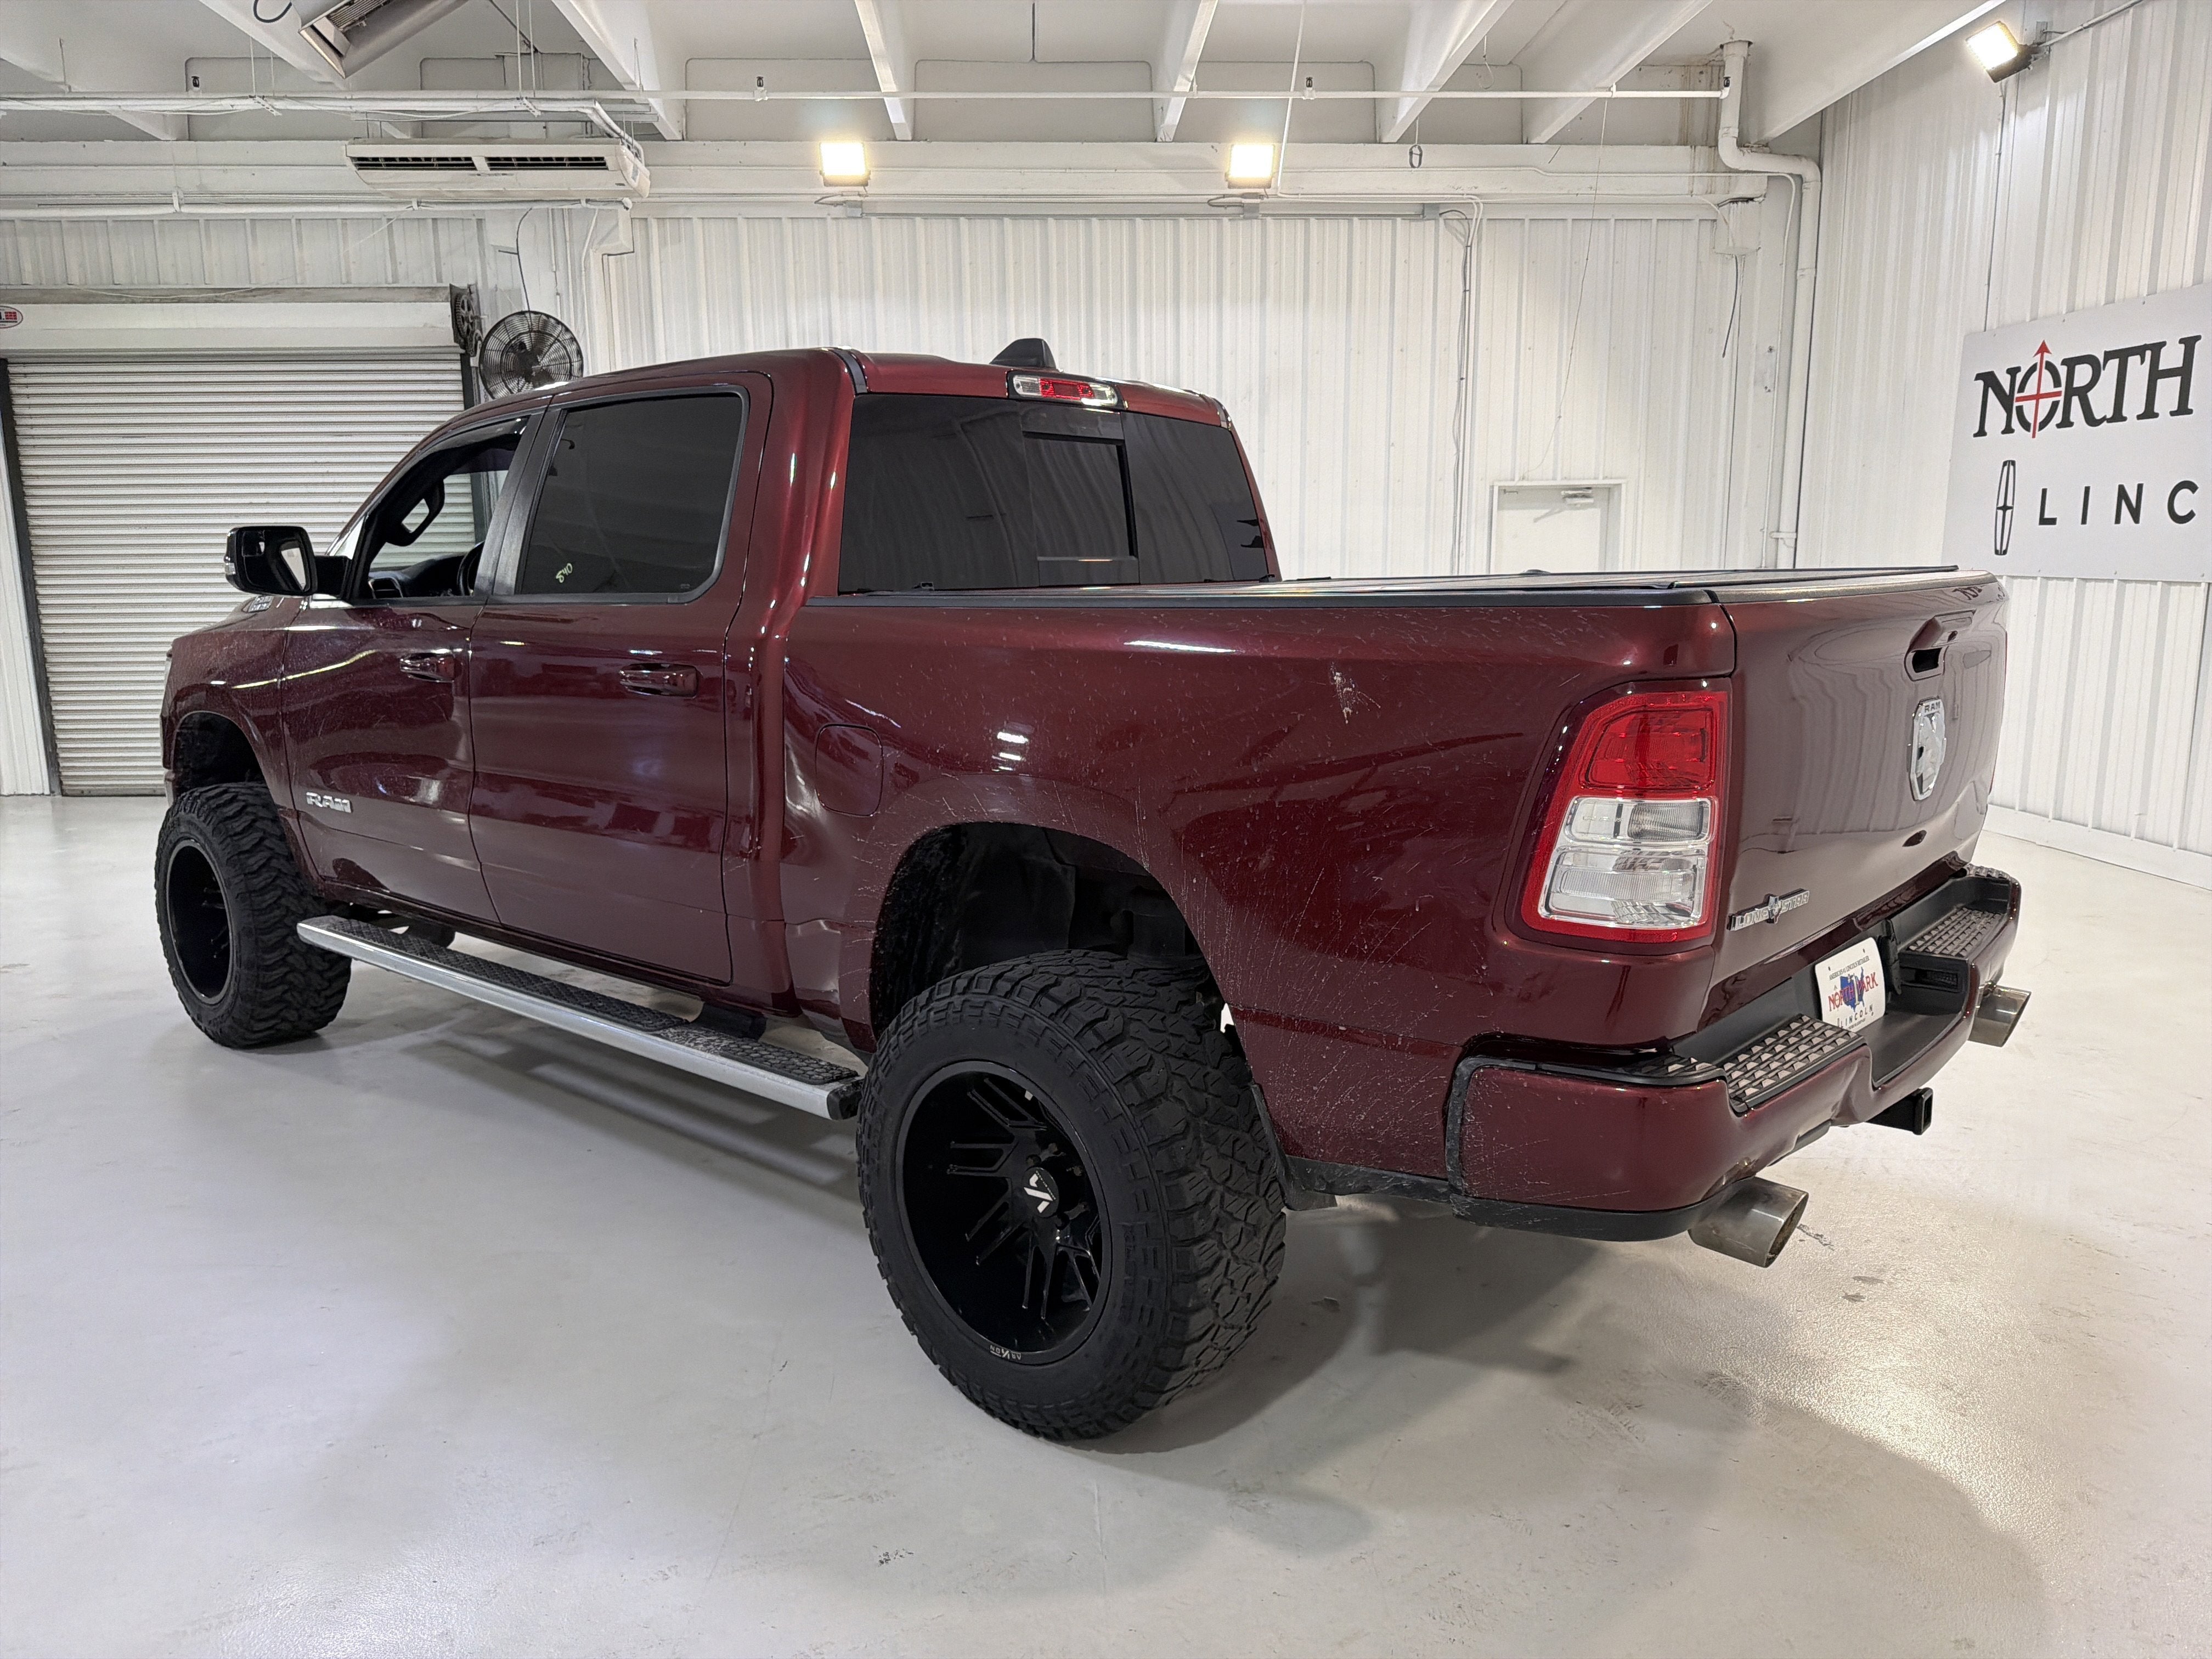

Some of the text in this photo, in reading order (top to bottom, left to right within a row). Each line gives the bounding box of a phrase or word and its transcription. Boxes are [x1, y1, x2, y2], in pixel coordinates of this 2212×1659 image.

[1973, 335, 2202, 438] NORTH
[2038, 480, 2199, 525] LINC
[1924, 701, 1940, 713] RAM
[306, 792, 352, 813] RAM
[1735, 890, 1809, 930] LONE STAR
[1828, 972, 1878, 1012] NORTH PARK
[1841, 1004, 1873, 1029] LINCOLN
